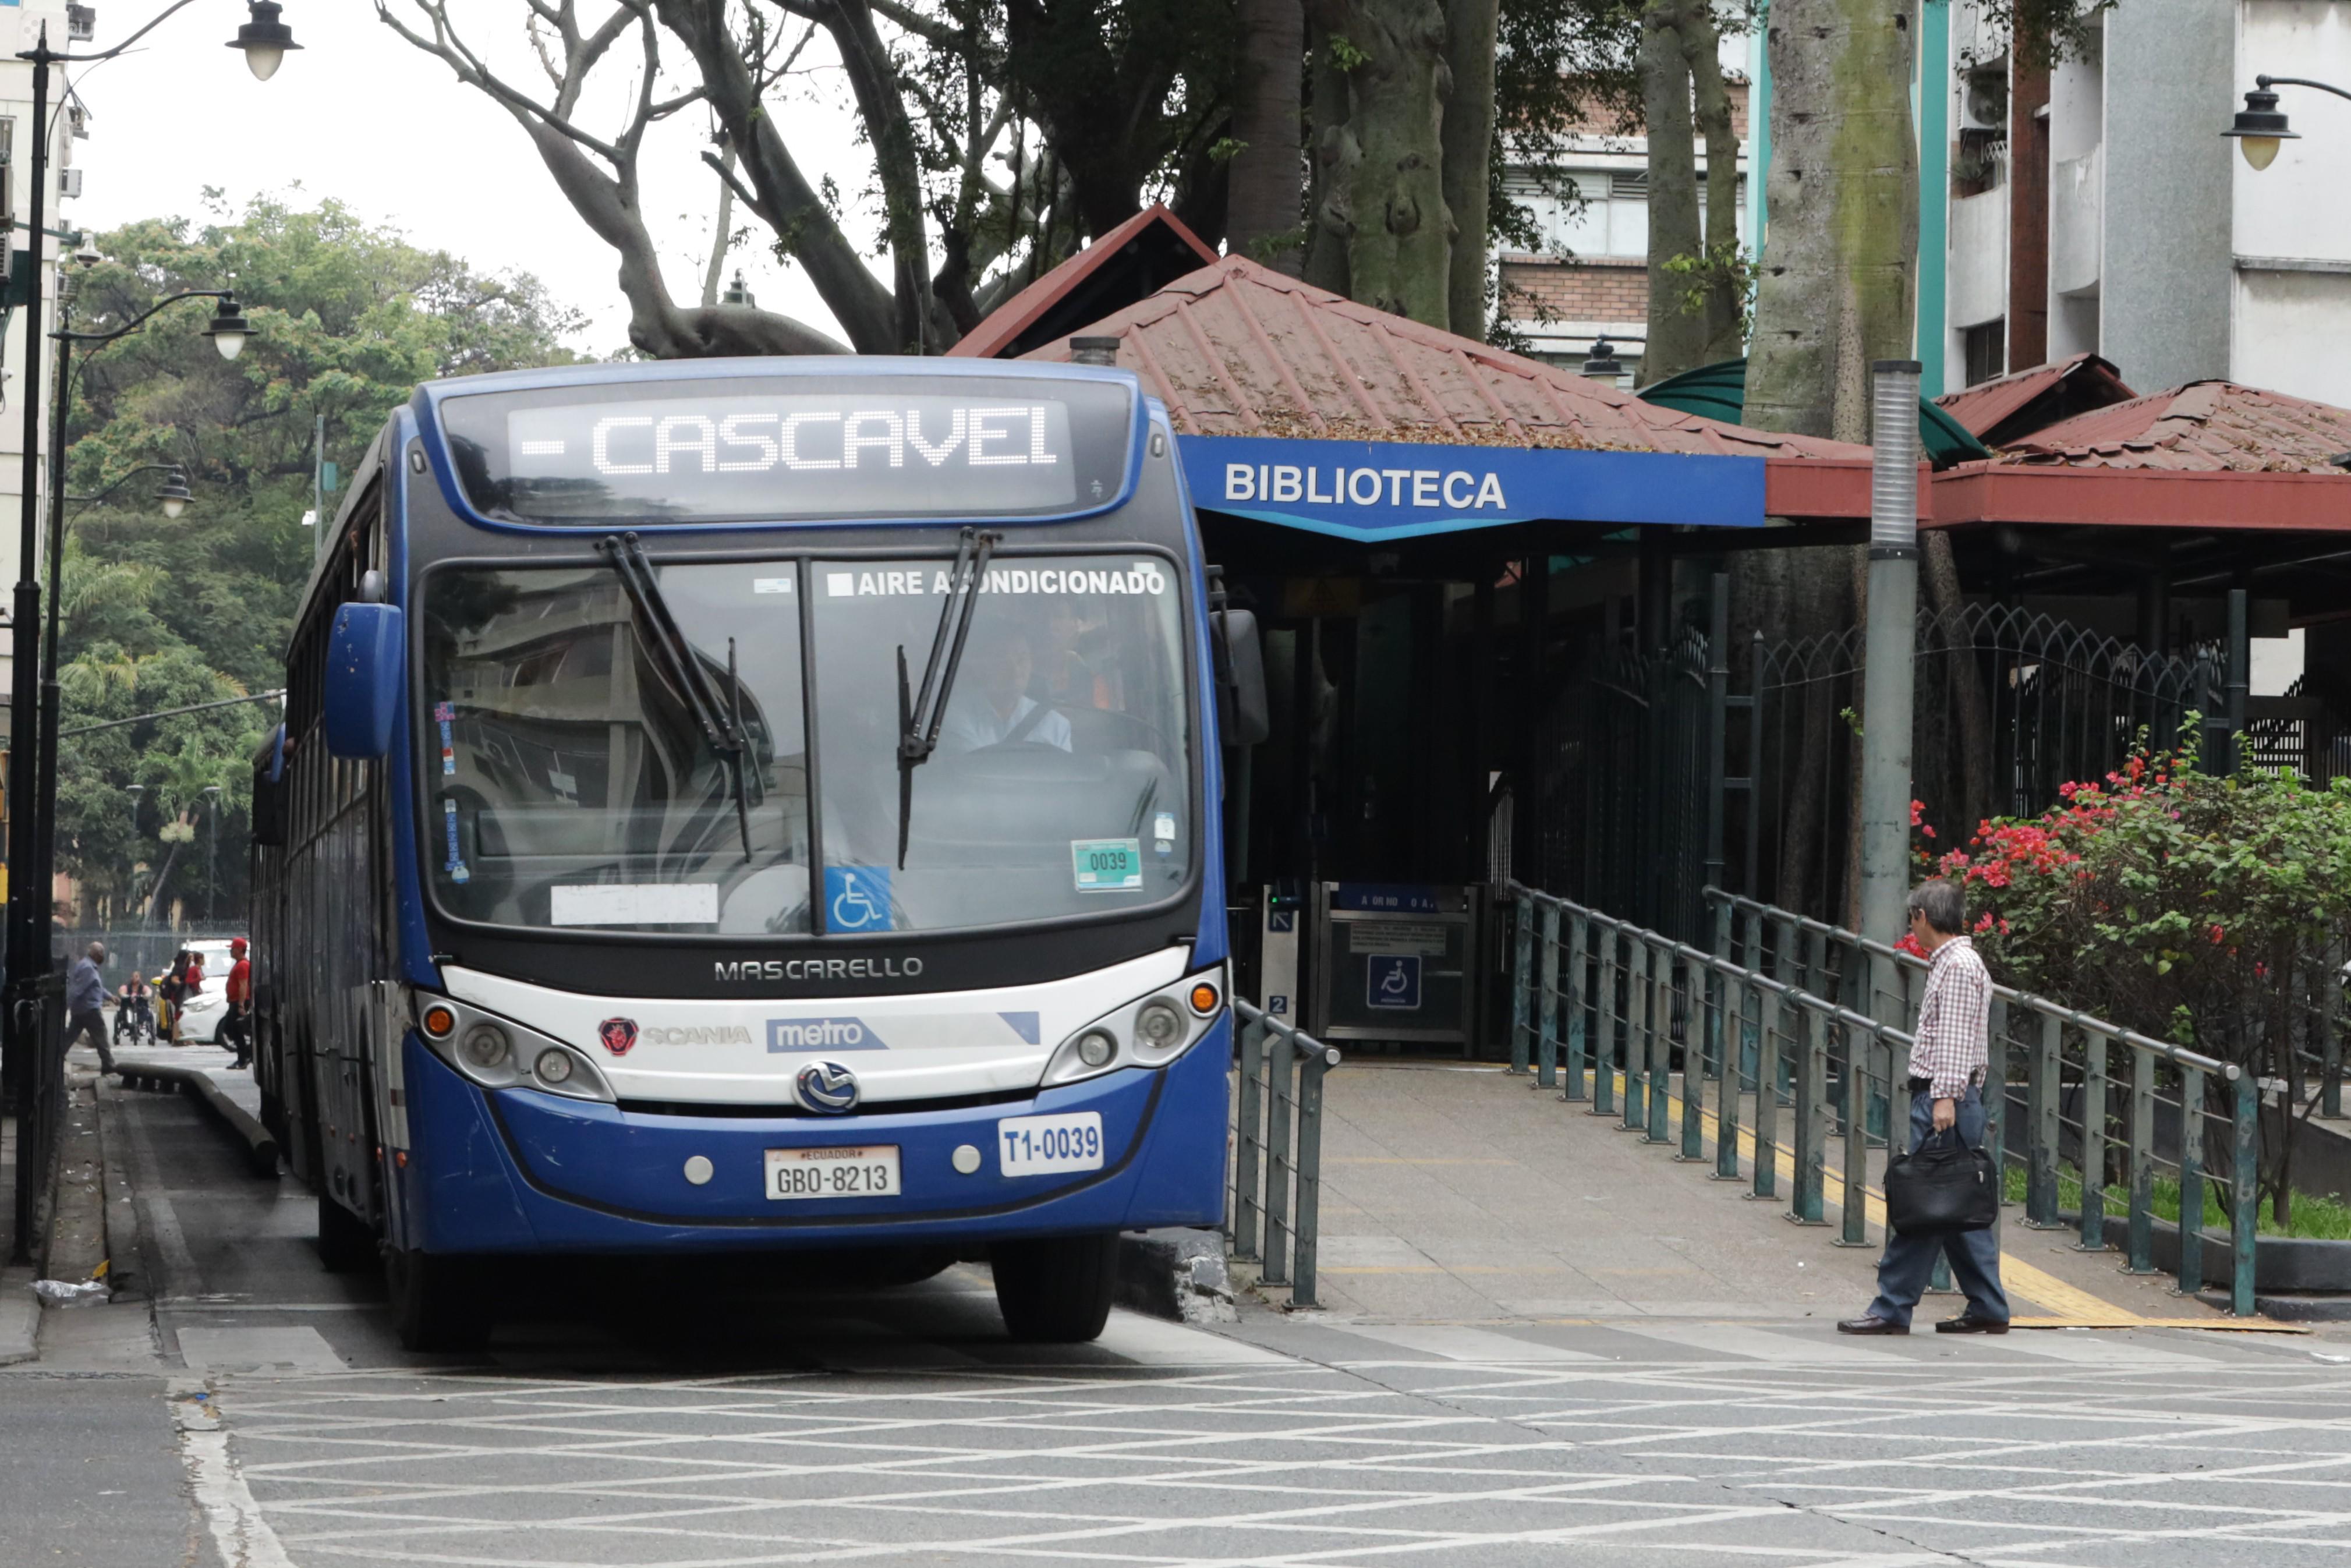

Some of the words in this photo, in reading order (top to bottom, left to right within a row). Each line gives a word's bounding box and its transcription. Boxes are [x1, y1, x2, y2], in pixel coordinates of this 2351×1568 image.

[593, 406, 1057, 474] CASCAVEL
[1226, 463, 1507, 510] BIBLIOTECA
[858, 571, 924, 596] AIRE
[1090, 852, 1126, 870] 0039
[715, 957, 923, 981] MASCARELLO
[1273, 997, 1284, 1013] 2
[642, 1026, 752, 1046] SCANIA
[776, 1020, 863, 1047] metro
[806, 1150, 856, 1160] ECUADOR
[1004, 1125, 1099, 1162] T1-0039
[777, 1165, 887, 1193] GBO-8213
